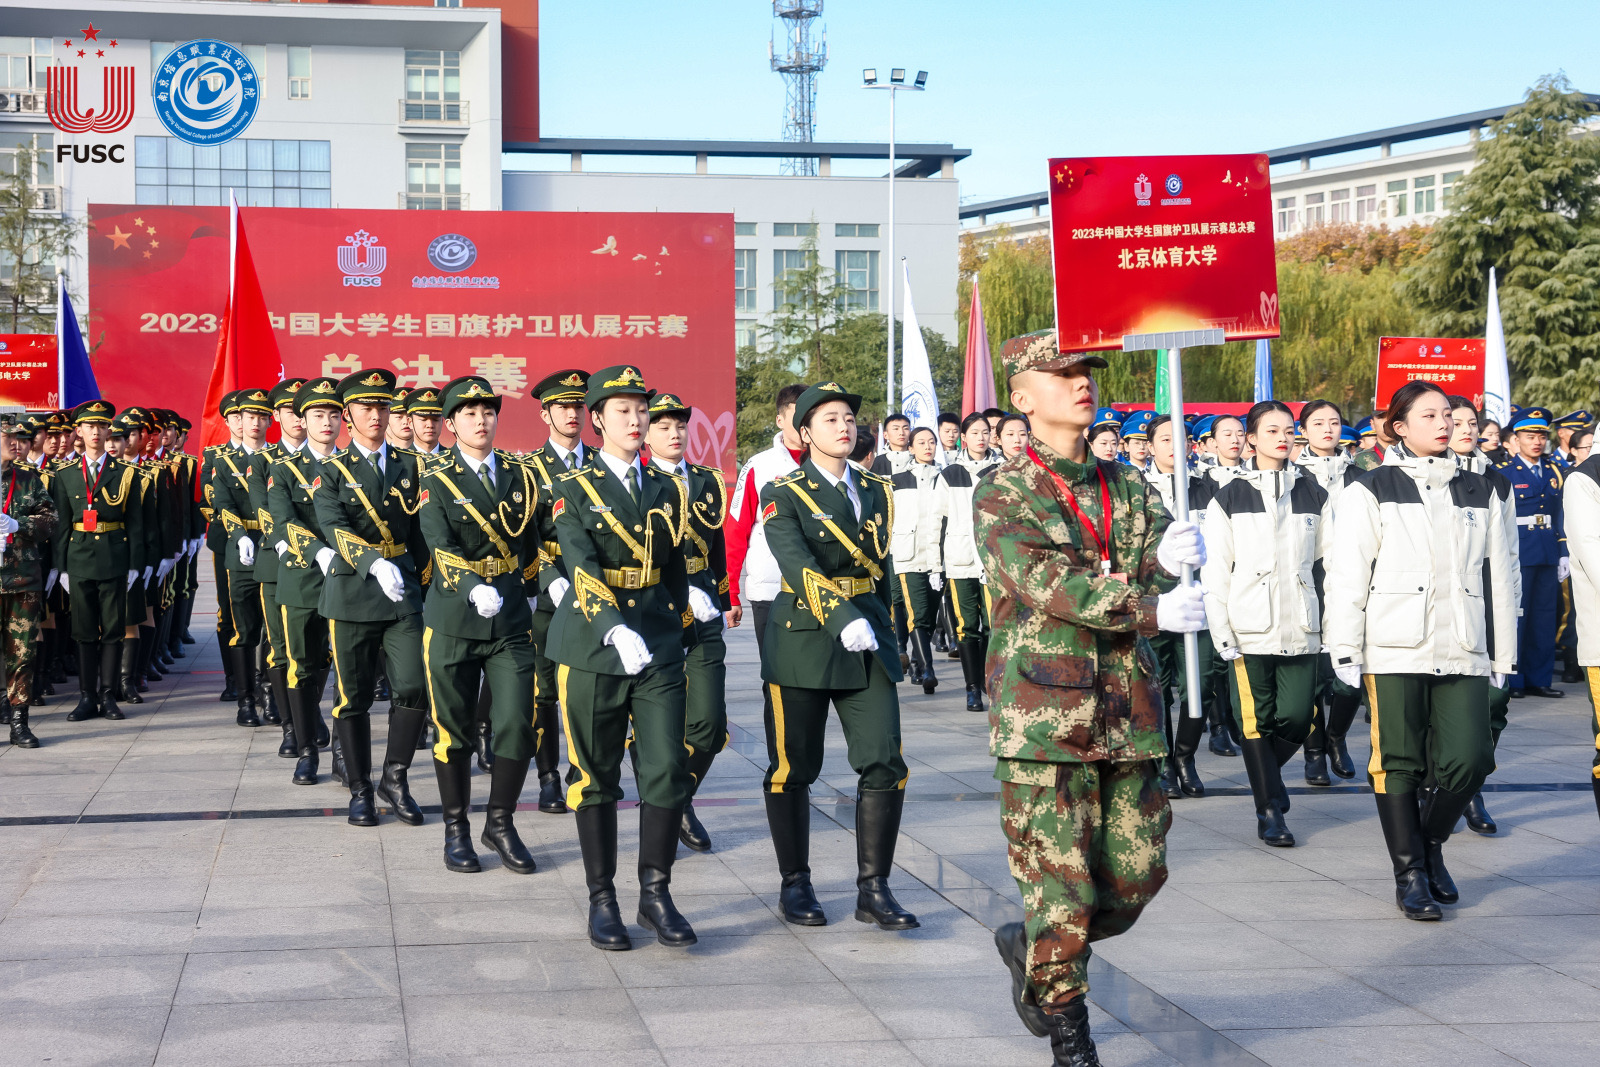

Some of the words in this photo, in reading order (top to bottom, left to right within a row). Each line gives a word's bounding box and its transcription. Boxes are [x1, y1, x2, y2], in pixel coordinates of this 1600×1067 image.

[1072, 221, 1255, 240] 2023年中国大学生国旗护卫队展示赛总决赛
[1118, 245, 1217, 269] 北京体育大学
[344, 277, 381, 286] FUSC
[139, 312, 689, 339] 2023国大学生国旗护卫队展示赛
[1407, 373, 1456, 382] 江西师范大学
